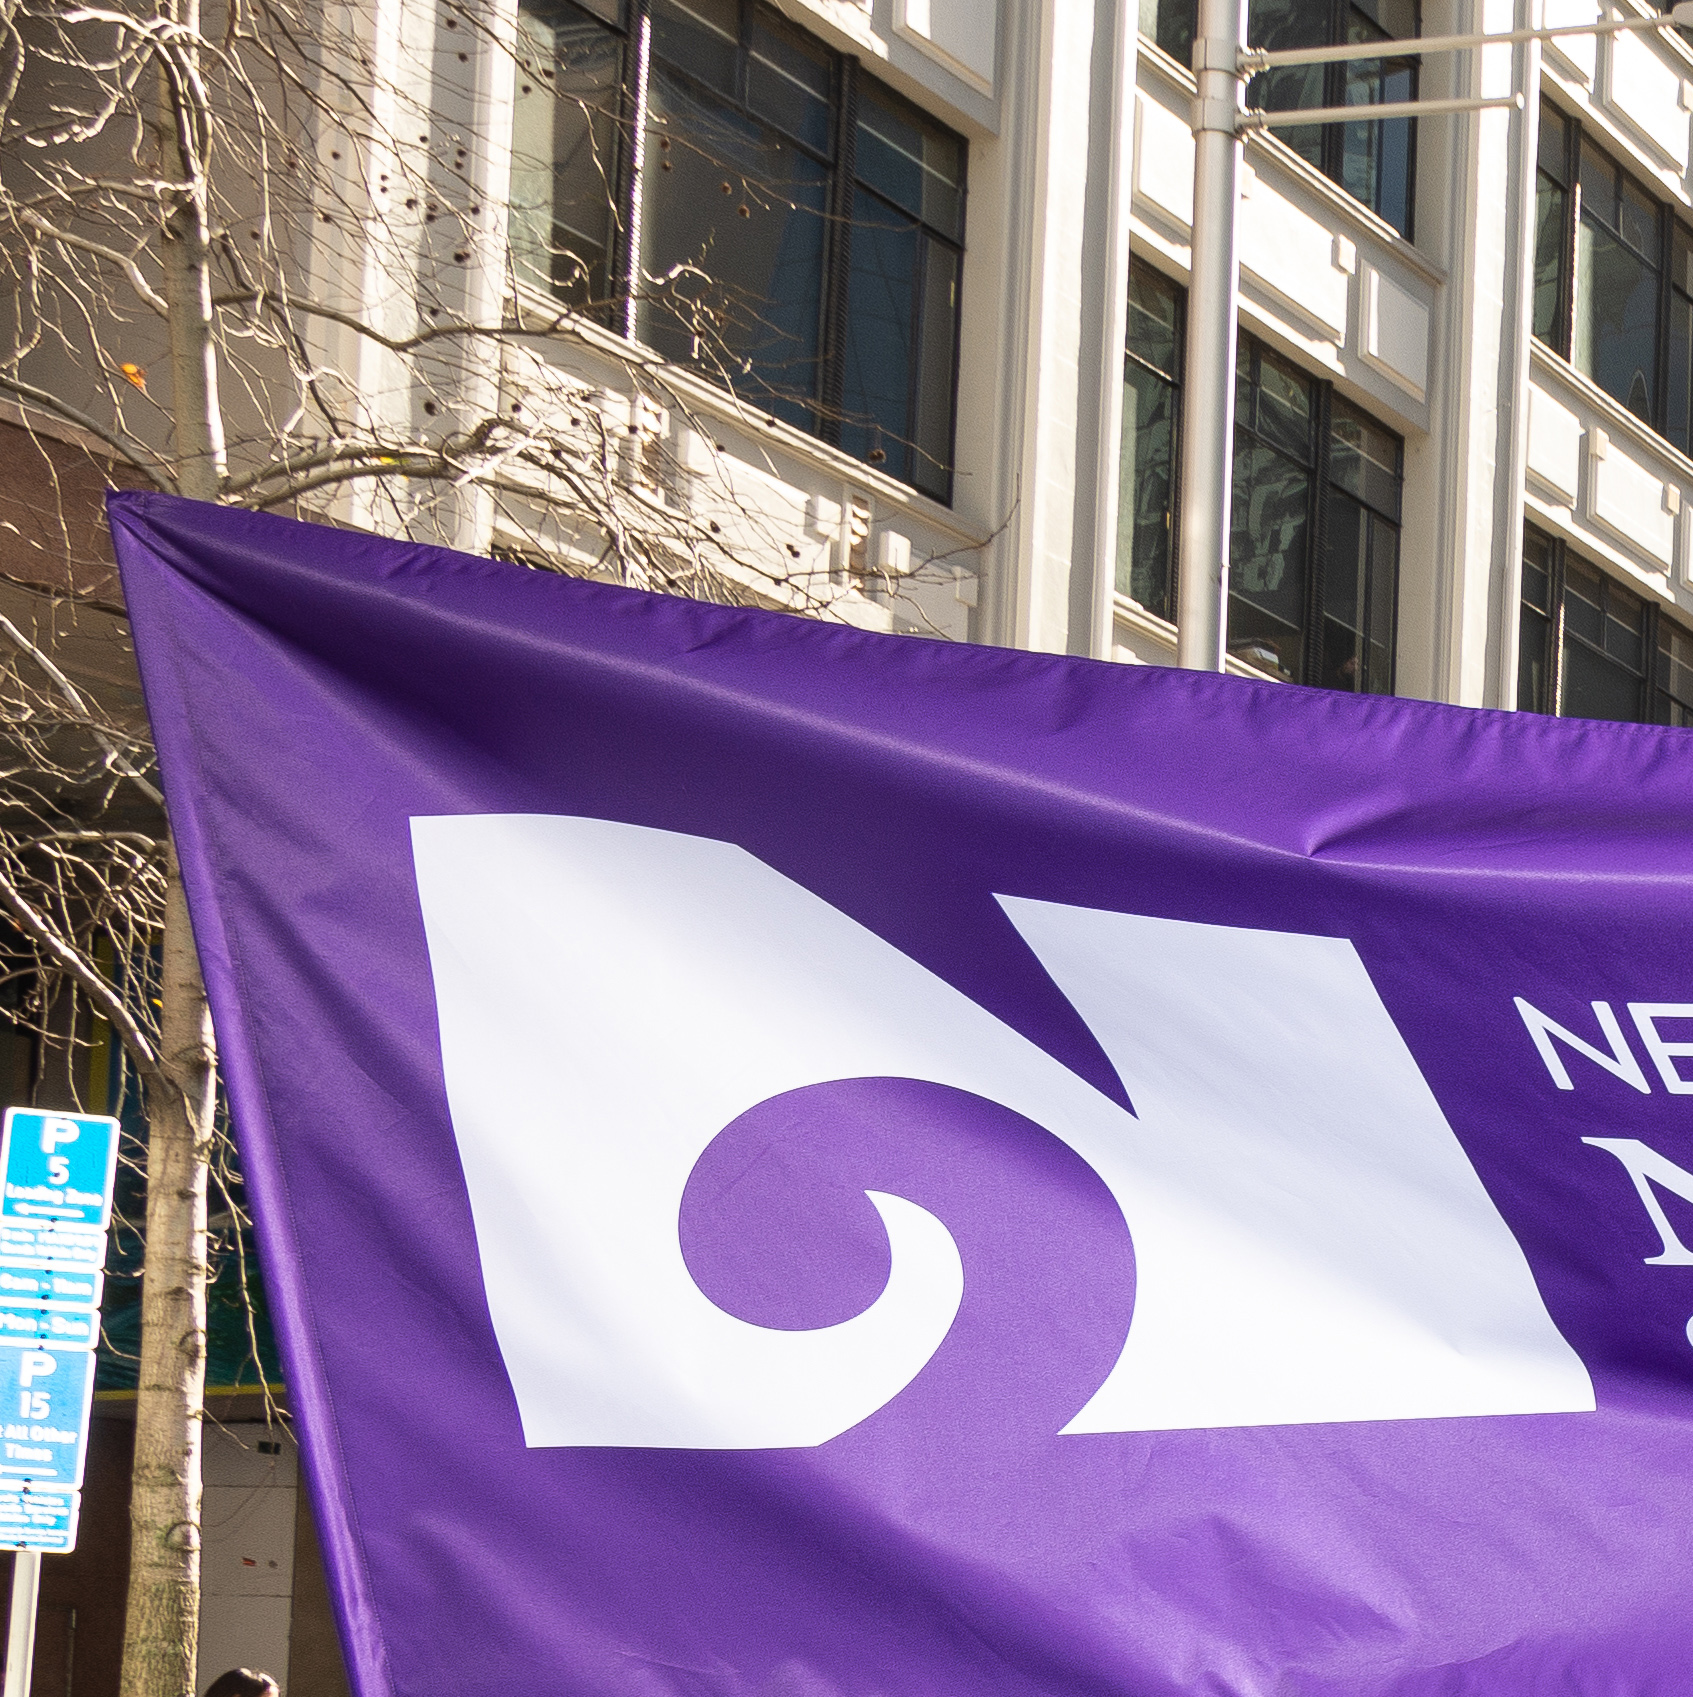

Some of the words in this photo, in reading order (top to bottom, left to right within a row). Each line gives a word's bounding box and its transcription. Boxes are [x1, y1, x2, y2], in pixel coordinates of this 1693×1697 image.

[42, 1117, 80, 1153] P
[49, 1156, 70, 1185] 5
[19, 1351, 58, 1388] P
[19, 1390, 51, 1420] 15
